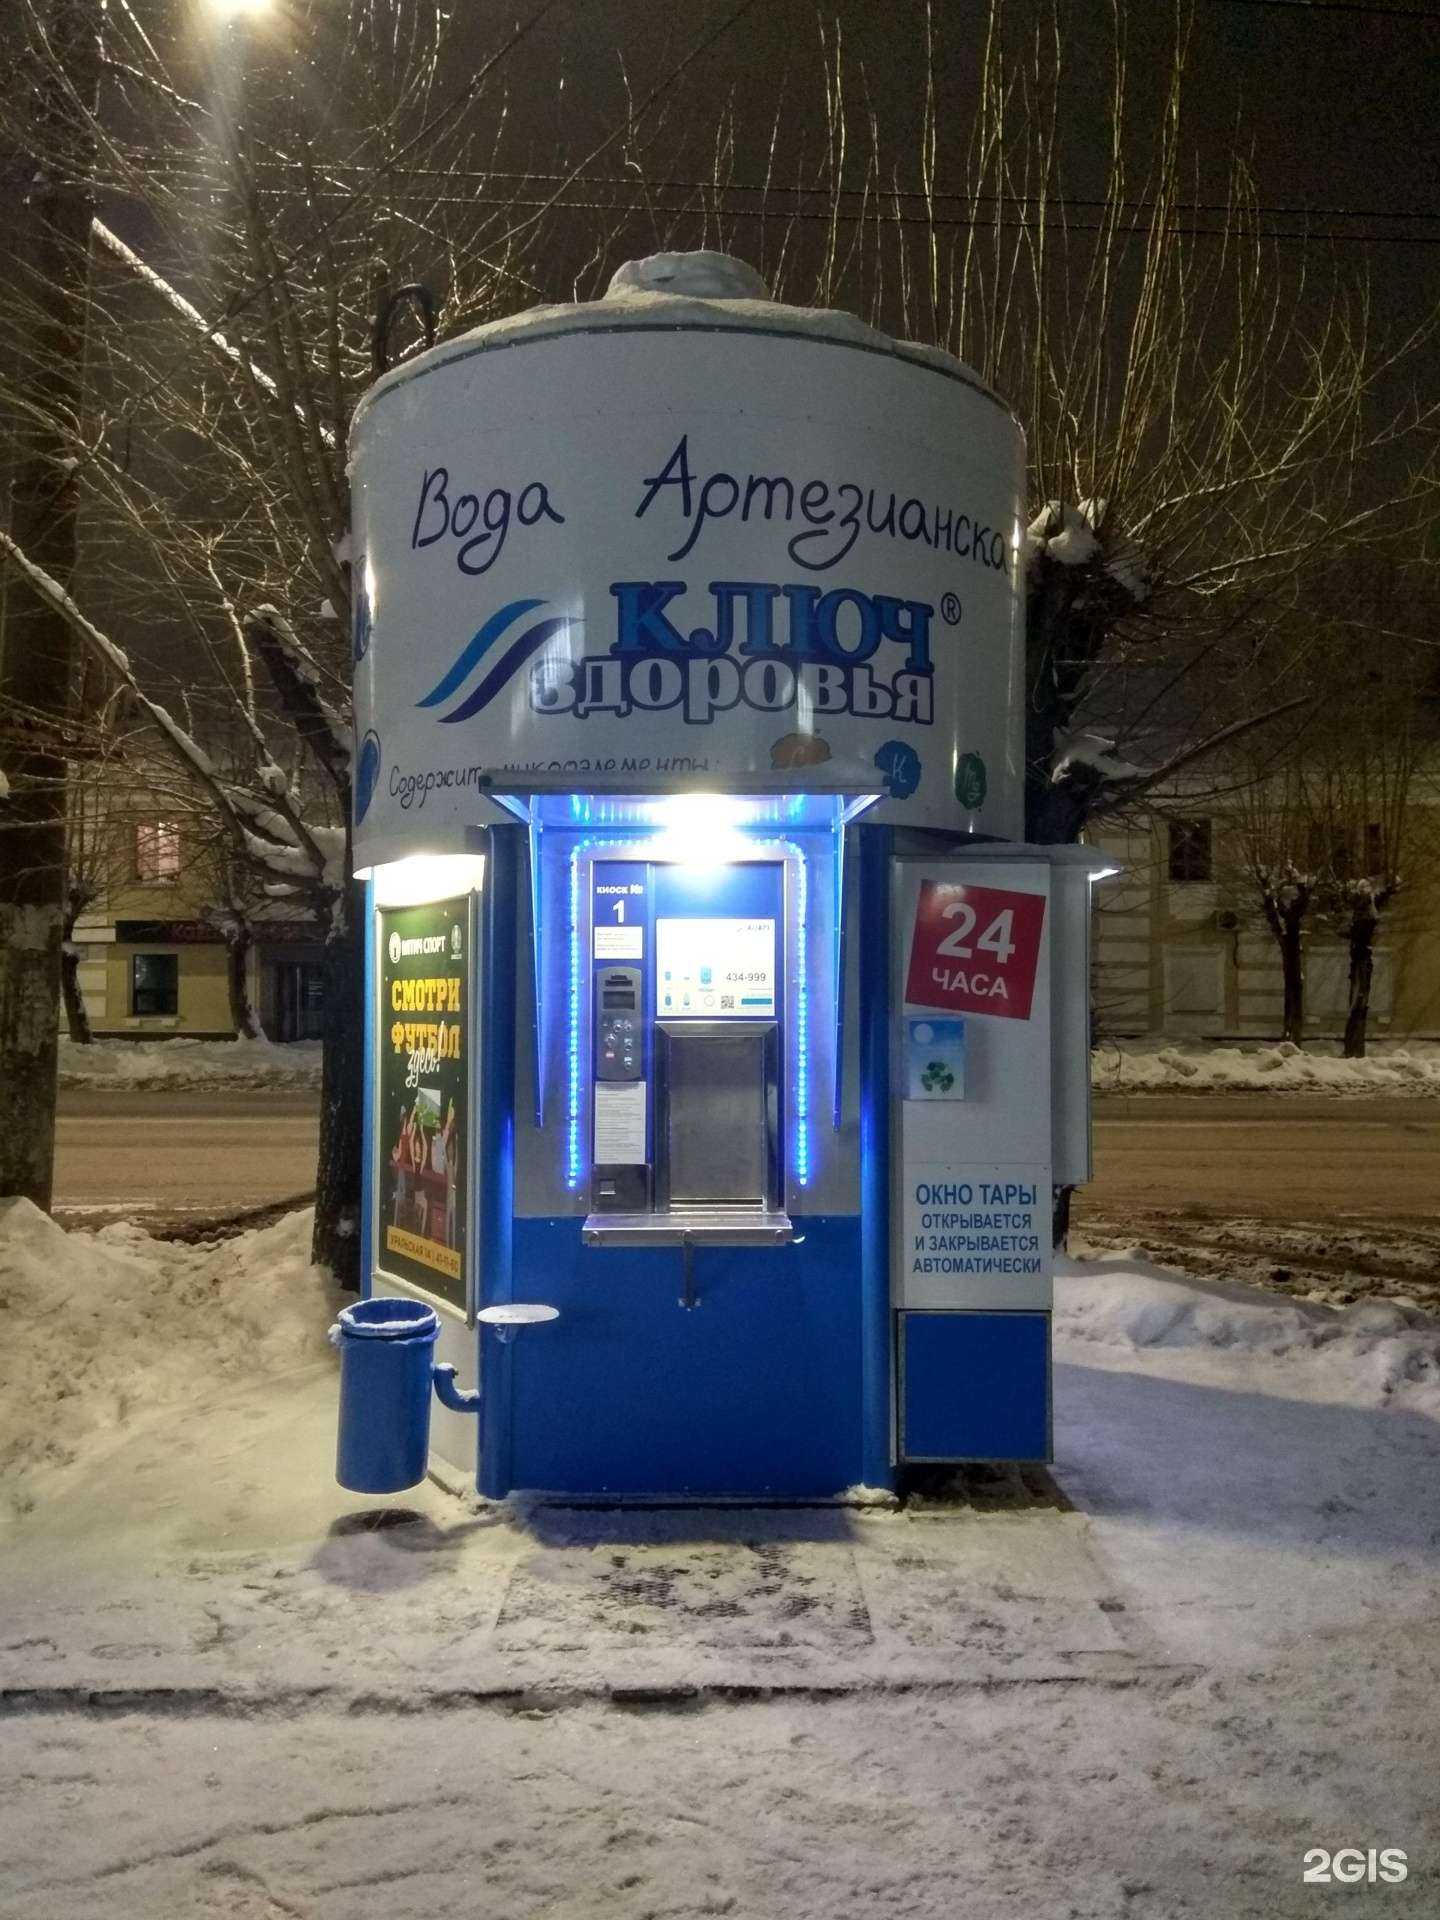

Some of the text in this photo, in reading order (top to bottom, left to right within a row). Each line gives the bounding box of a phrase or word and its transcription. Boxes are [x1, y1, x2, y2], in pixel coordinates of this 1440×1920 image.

[413, 467, 565, 575] Вода
[609, 580, 935, 674] КЛЮЧ
[390, 765, 482, 809] Содержит
[612, 899, 625, 923] 1
[936, 902, 1015, 964] 24
[726, 972, 767, 981] 434-999
[932, 967, 1008, 999] ЧАСА
[392, 978, 460, 1012] СМОТРИ
[391, 1021, 461, 1059] ФУТБОЛ
[916, 1184, 1037, 1205] ОКНО ТАРЫ
[922, 1213, 1031, 1229] ОТКРЫВАЕТСЯ
[915, 1236, 1039, 1251] И ЗАКРЫВАЕТСЯ
[913, 1257, 1041, 1273] АВТОМАТИЧЕСКИ
